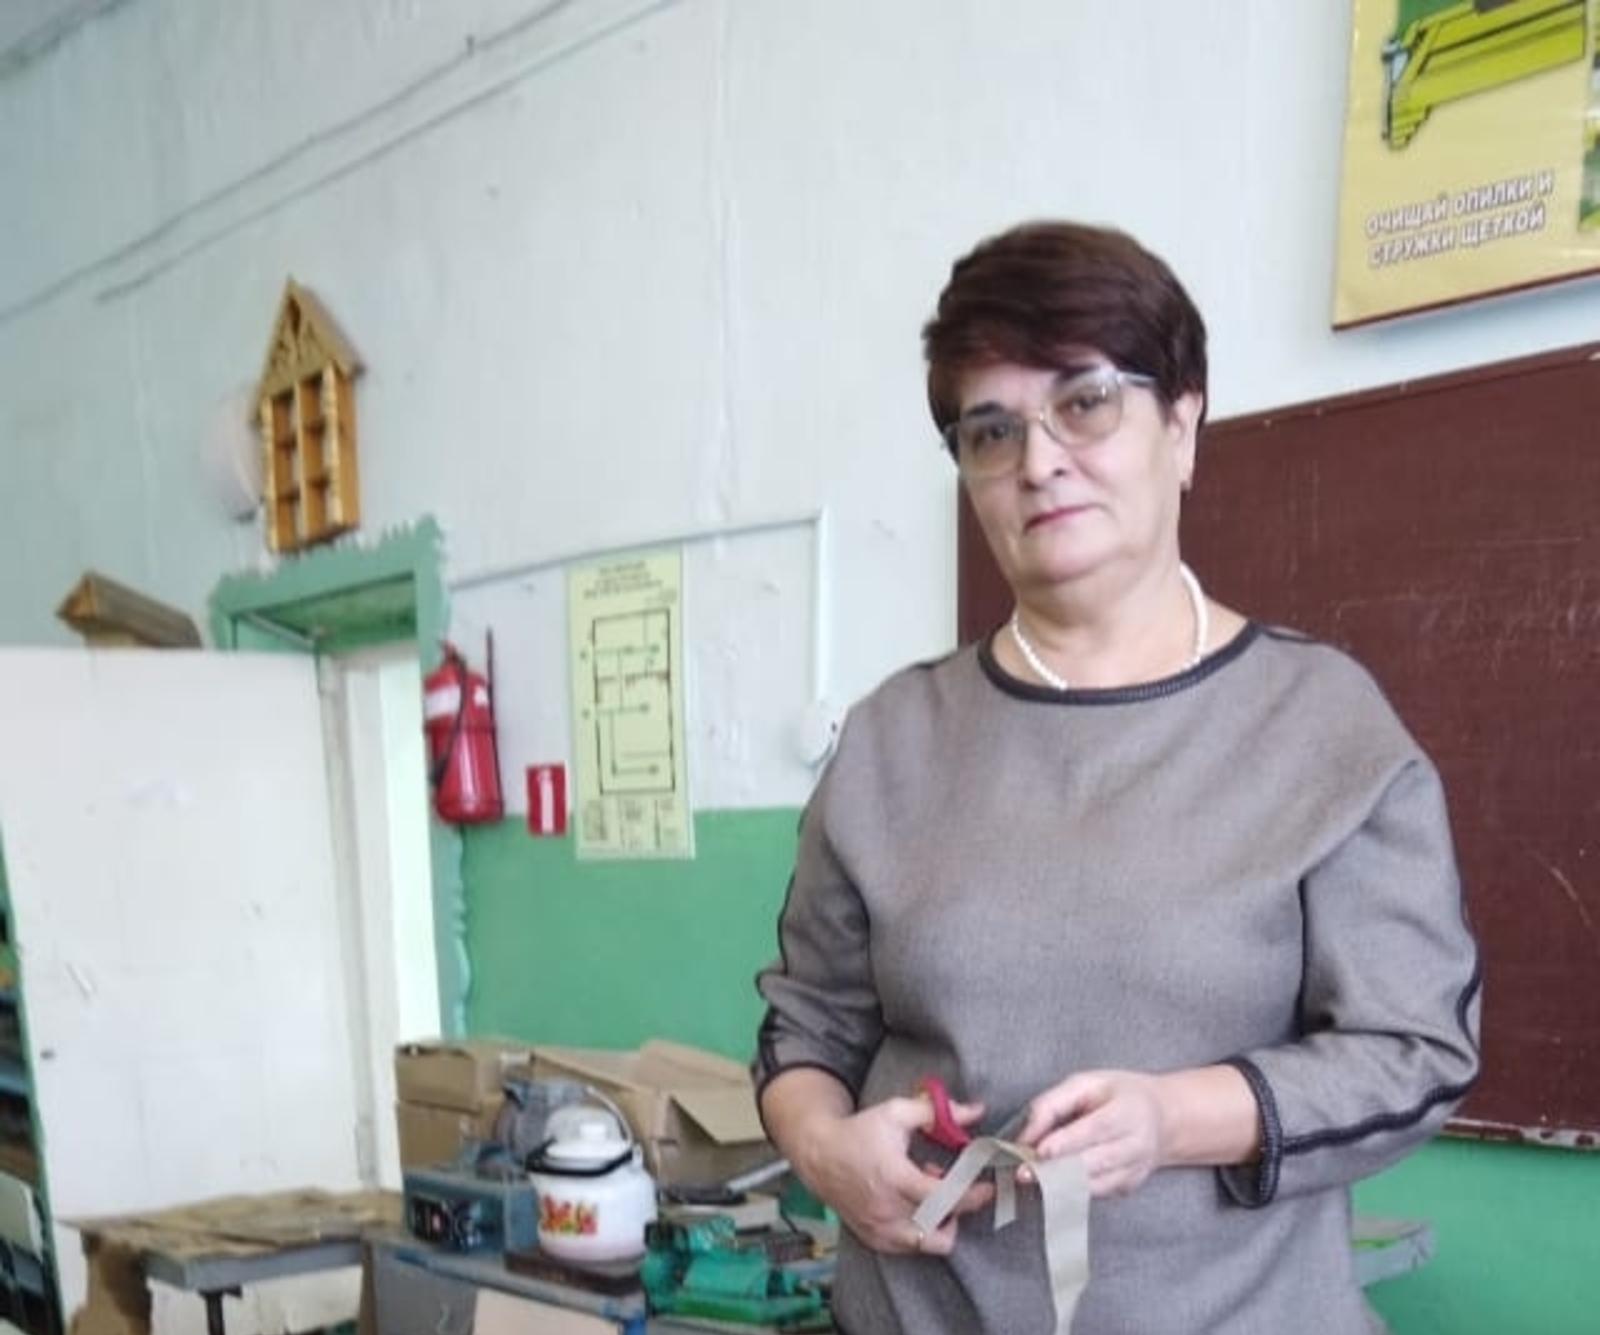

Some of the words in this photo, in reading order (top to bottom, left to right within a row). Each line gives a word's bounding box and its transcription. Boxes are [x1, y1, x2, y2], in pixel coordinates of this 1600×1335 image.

[1366, 193, 1449, 237] ОЧИЩАЙ
[1454, 176, 1533, 215] ОПИЛКИ
[1538, 169, 1554, 195] И
[1368, 229, 1455, 267] СТРУЖКИ
[1461, 203, 1545, 246] ЩЕТКОЙ
